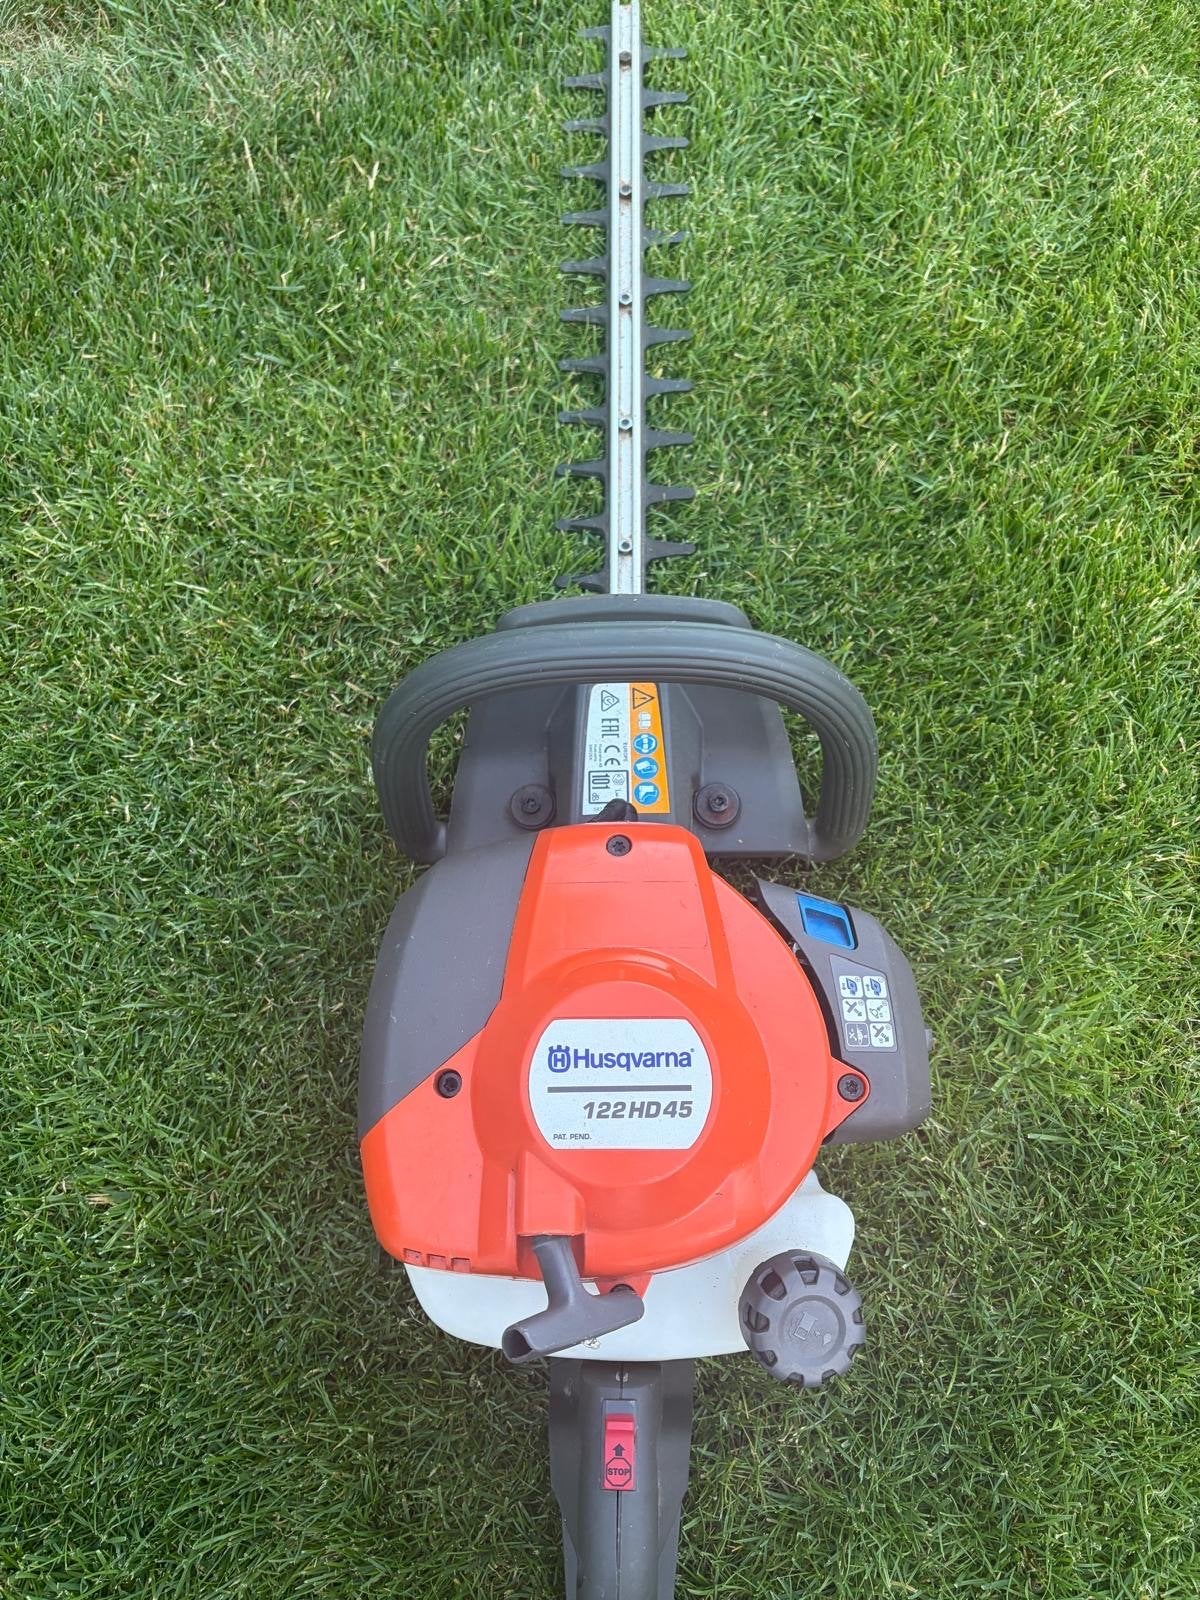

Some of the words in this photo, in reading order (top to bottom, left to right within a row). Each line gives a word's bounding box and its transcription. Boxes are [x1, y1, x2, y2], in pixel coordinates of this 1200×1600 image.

[605, 745, 620, 766] CE
[592, 774, 610, 790] 101
[573, 1048, 692, 1071] Husqvarna
[583, 1101, 693, 1119] 122HD45
[553, 1133, 568, 1141] PAT.
[569, 1133, 592, 1141] PEND.
[607, 1467, 630, 1476] STOP
